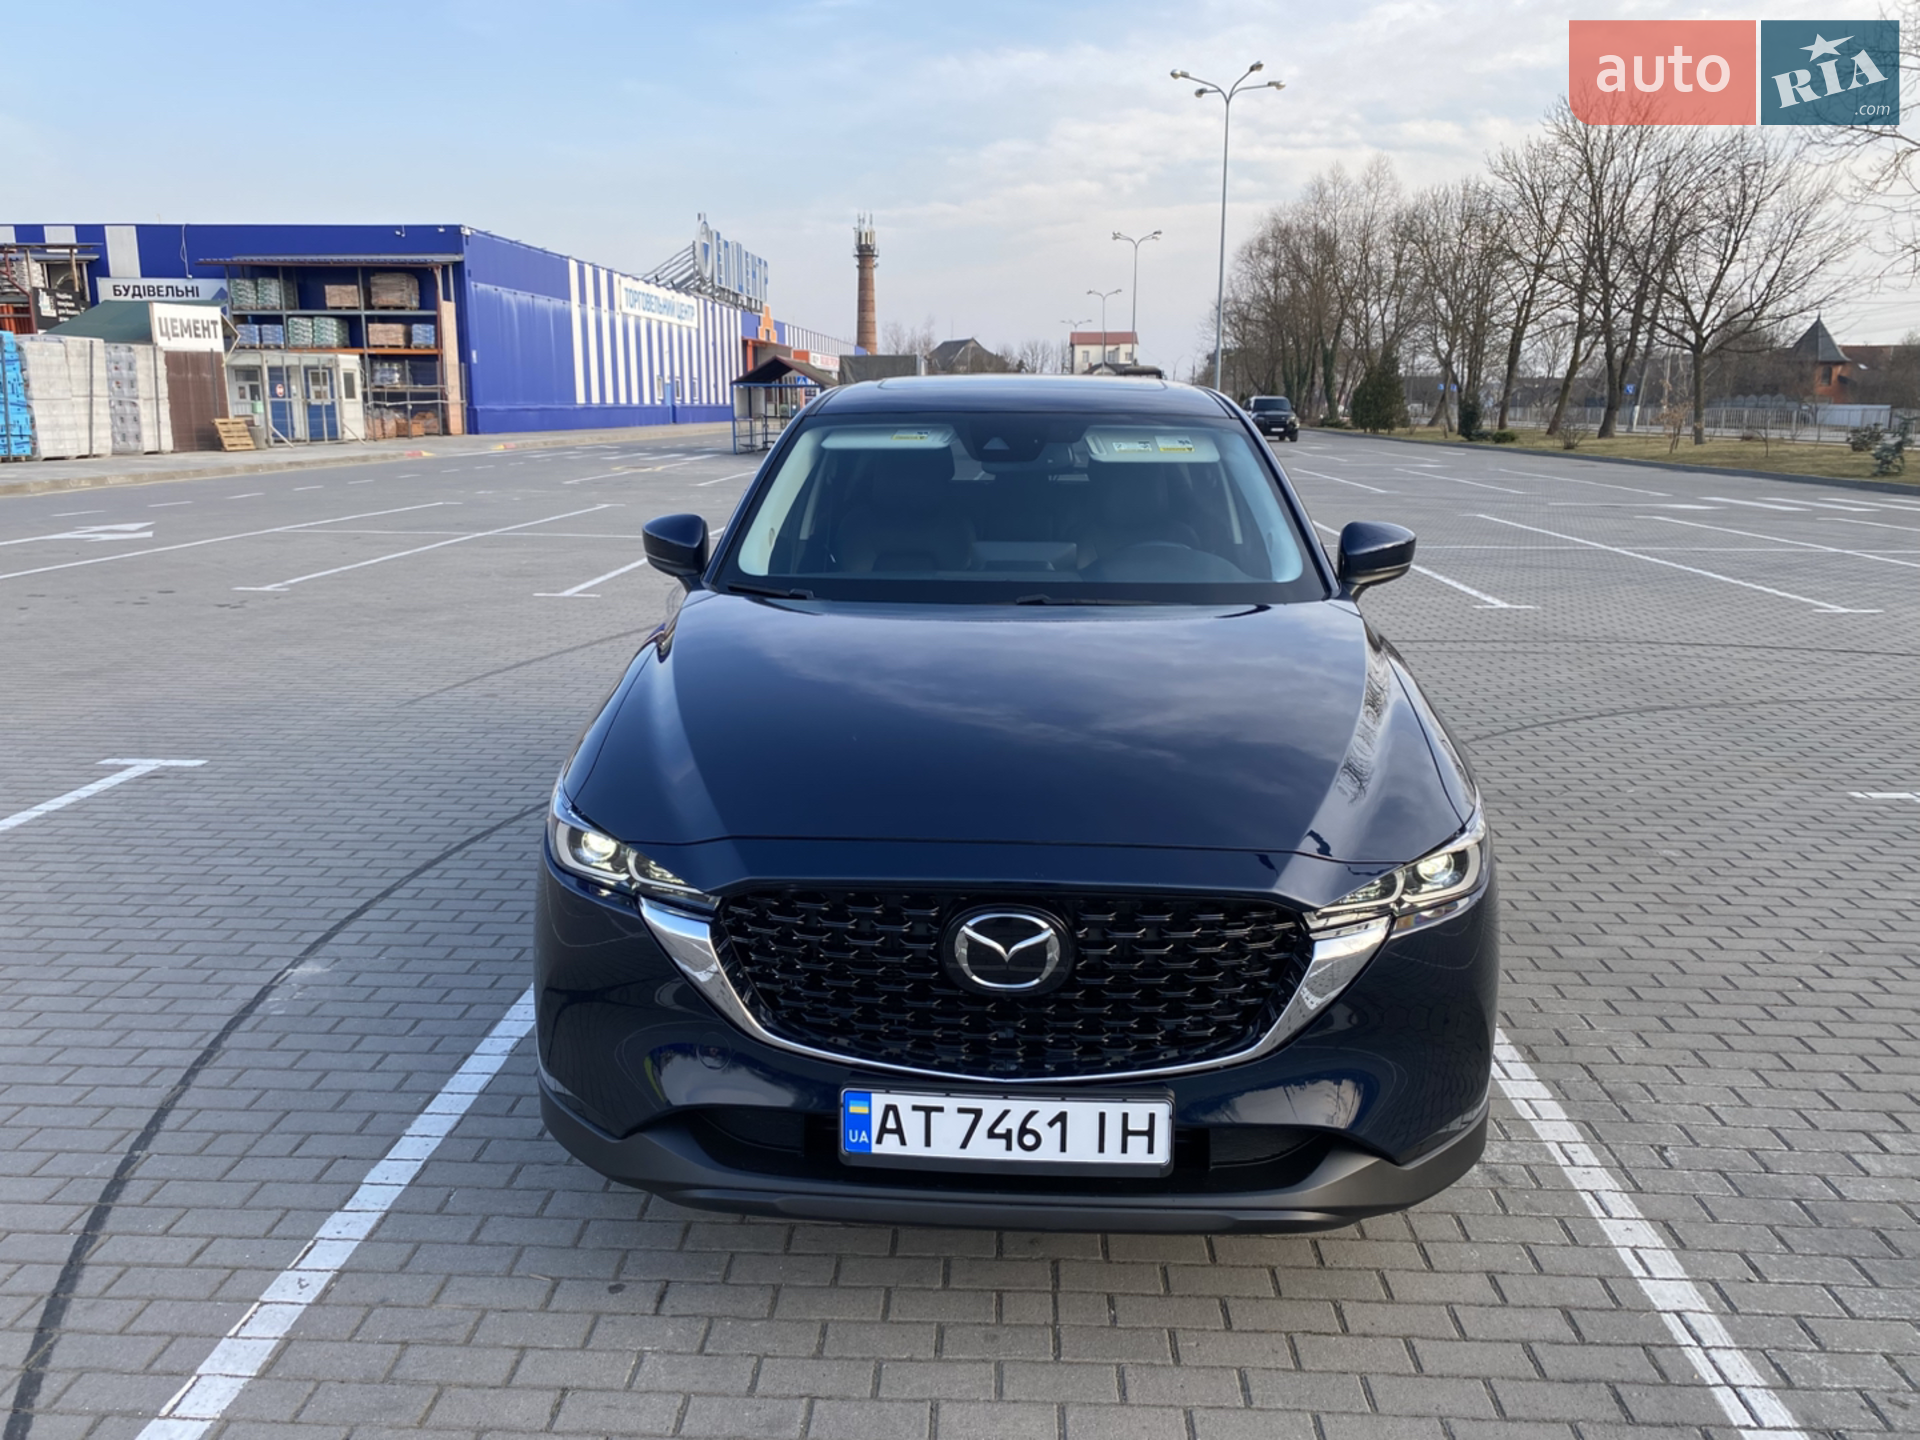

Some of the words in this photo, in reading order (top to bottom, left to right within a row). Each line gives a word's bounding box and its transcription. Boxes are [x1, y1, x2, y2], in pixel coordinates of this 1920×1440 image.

[112, 284, 200, 299] БУДІВЕЛЬНІ
[157, 316, 219, 341] ЦЕМЕНТ
[848, 1129, 869, 1144] UA
[875, 1103, 945, 1148] AT
[957, 1106, 1068, 1153] 7461
[1097, 1110, 1156, 1155] IH
